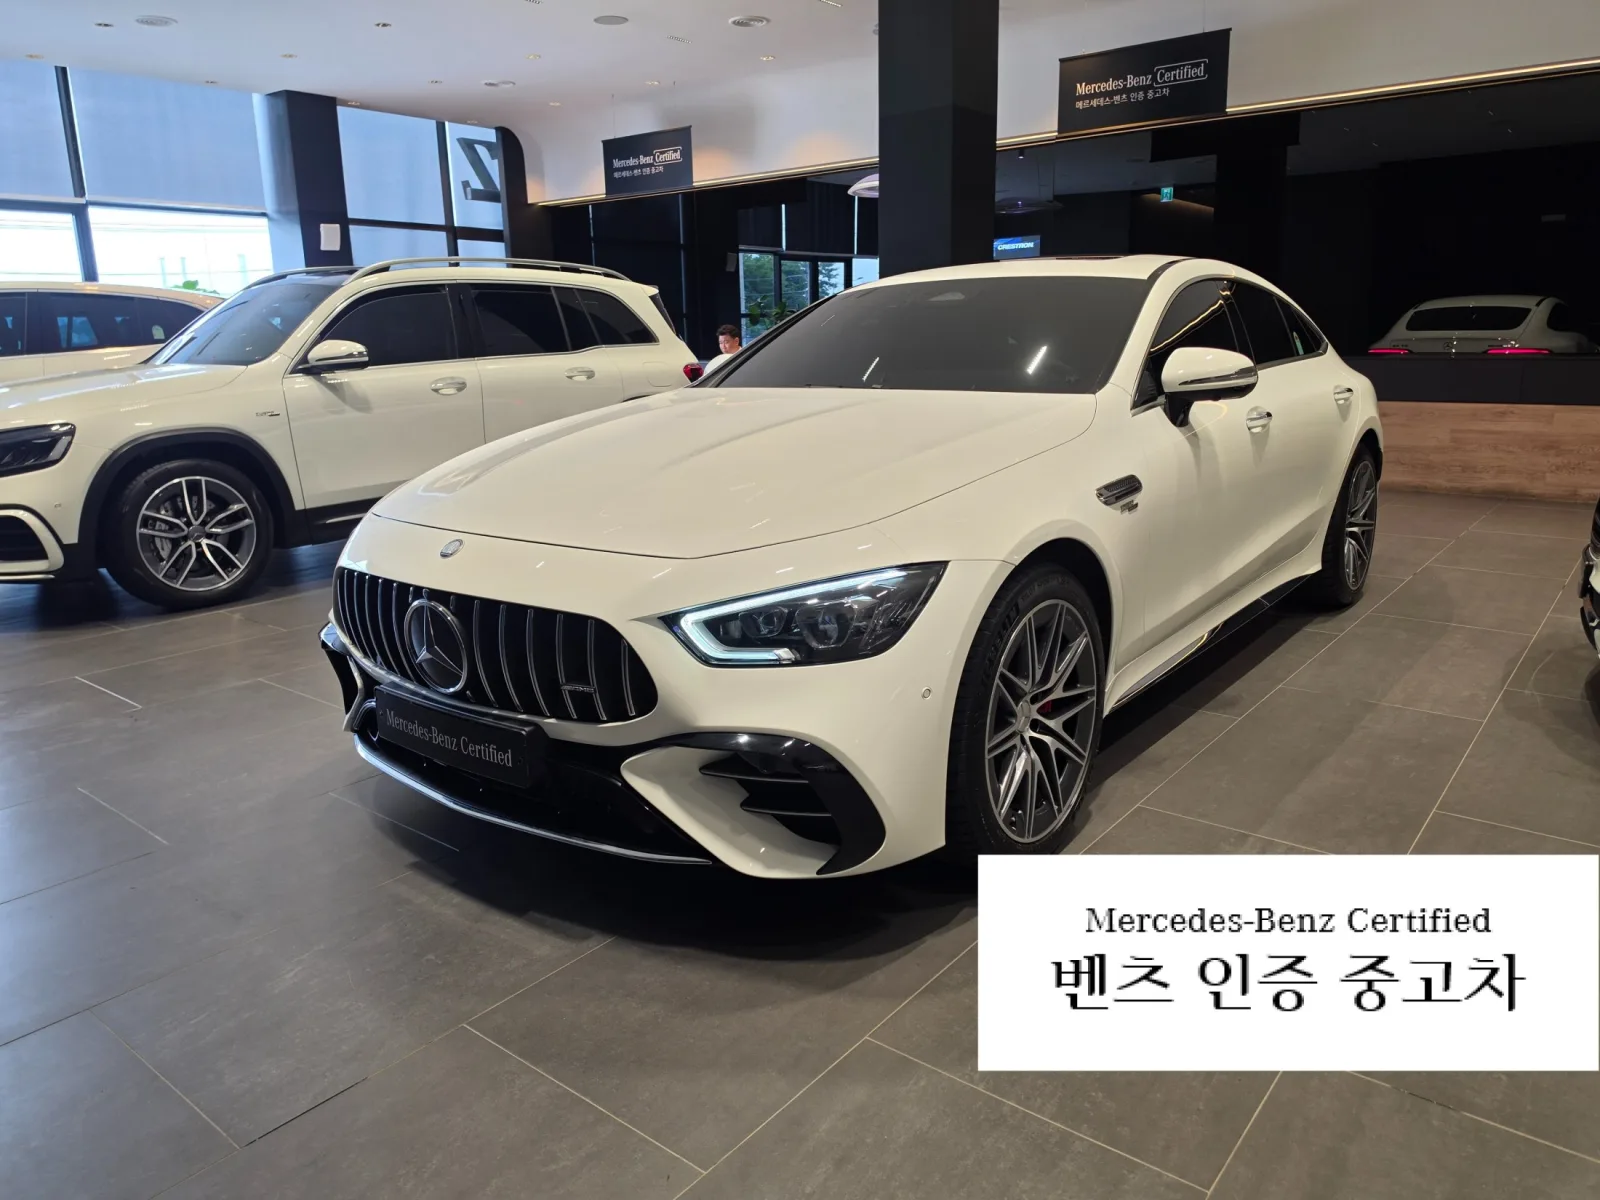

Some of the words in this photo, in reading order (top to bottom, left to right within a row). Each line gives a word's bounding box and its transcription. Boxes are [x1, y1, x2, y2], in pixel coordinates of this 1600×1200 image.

[1075, 74, 1152, 96] Mercedes-Benz
[1156, 63, 1205, 83] Certified
[1075, 95, 1128, 109] 메르세데스-벤츠
[1129, 91, 1145, 102] 인증
[1146, 86, 1171, 100] 중고차
[613, 155, 653, 168] Mercedes-Benz
[655, 149, 681, 163] Certified
[997, 242, 1034, 250] CRESTRON
[386, 708, 458, 751] Mercedes-Benz
[460, 735, 513, 768] Certified
